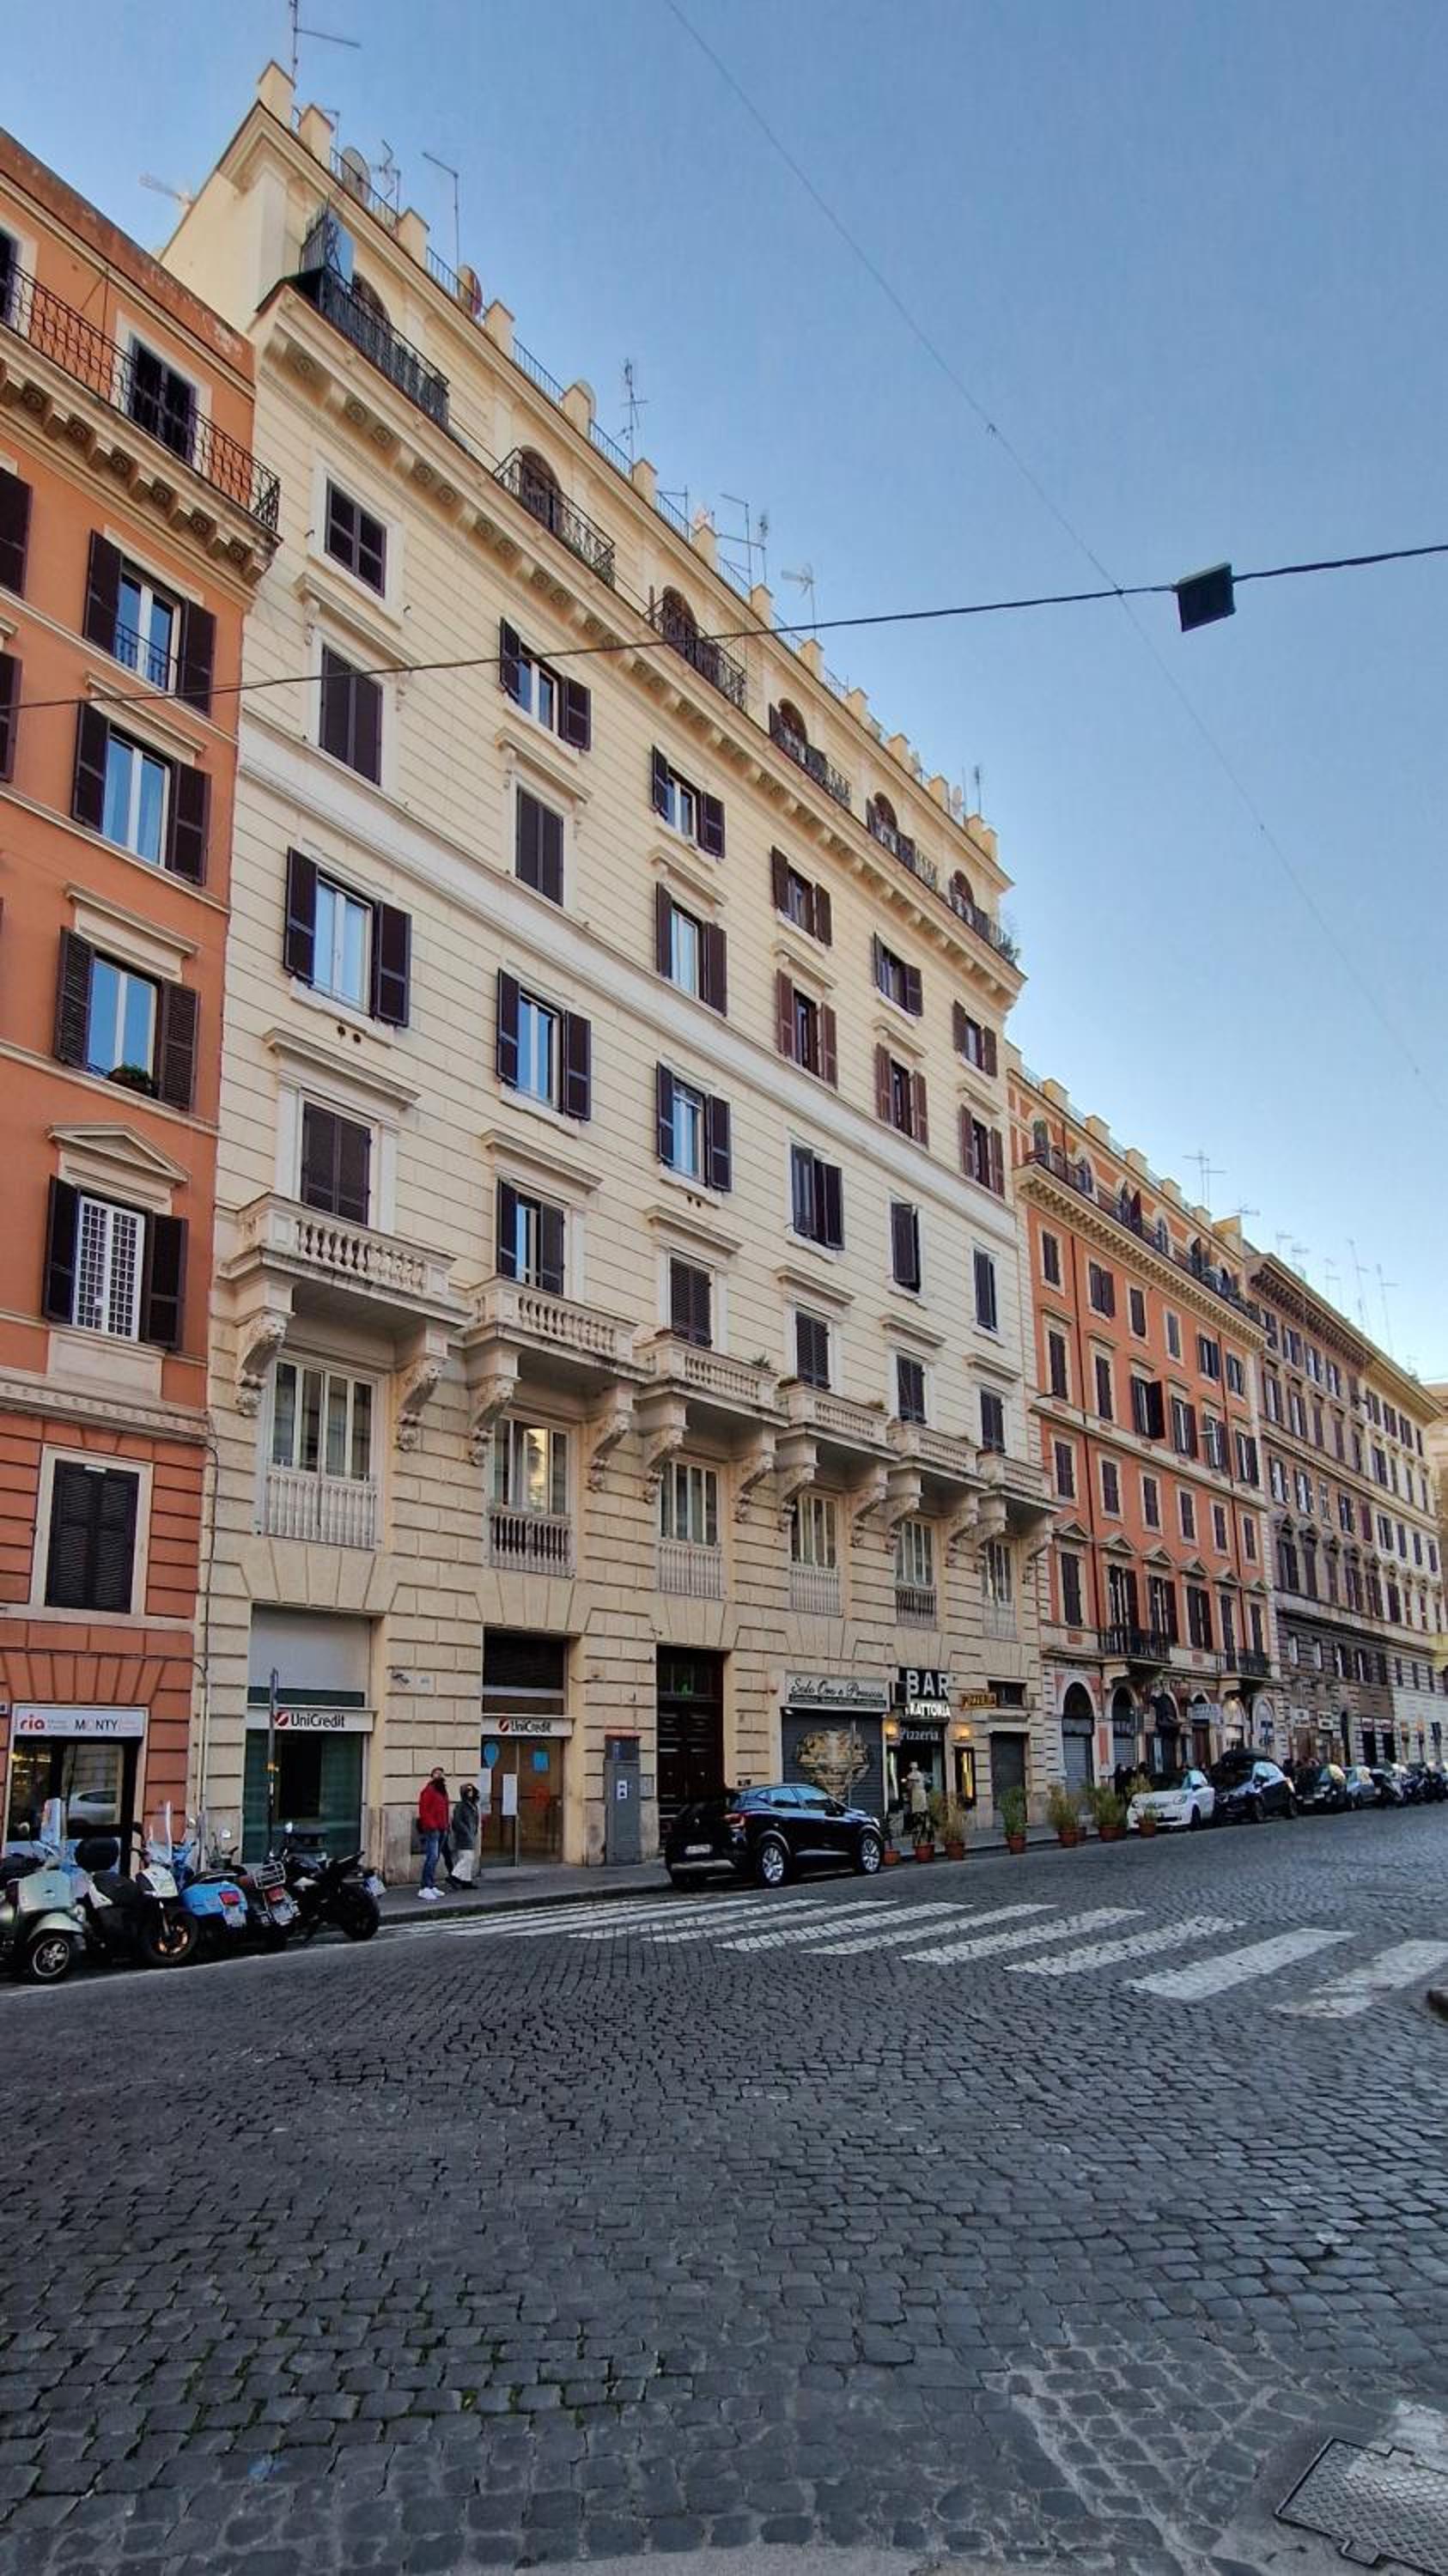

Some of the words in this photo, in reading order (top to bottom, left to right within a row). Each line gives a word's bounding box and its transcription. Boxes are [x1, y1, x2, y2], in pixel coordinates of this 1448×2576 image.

[907, 1670, 949, 1697] BAR
[20, 1714, 46, 1730] ria
[292, 1712, 344, 1728] UniCredit
[511, 1719, 552, 1733] UniCredit
[900, 1728, 939, 1741] Pizzeria
